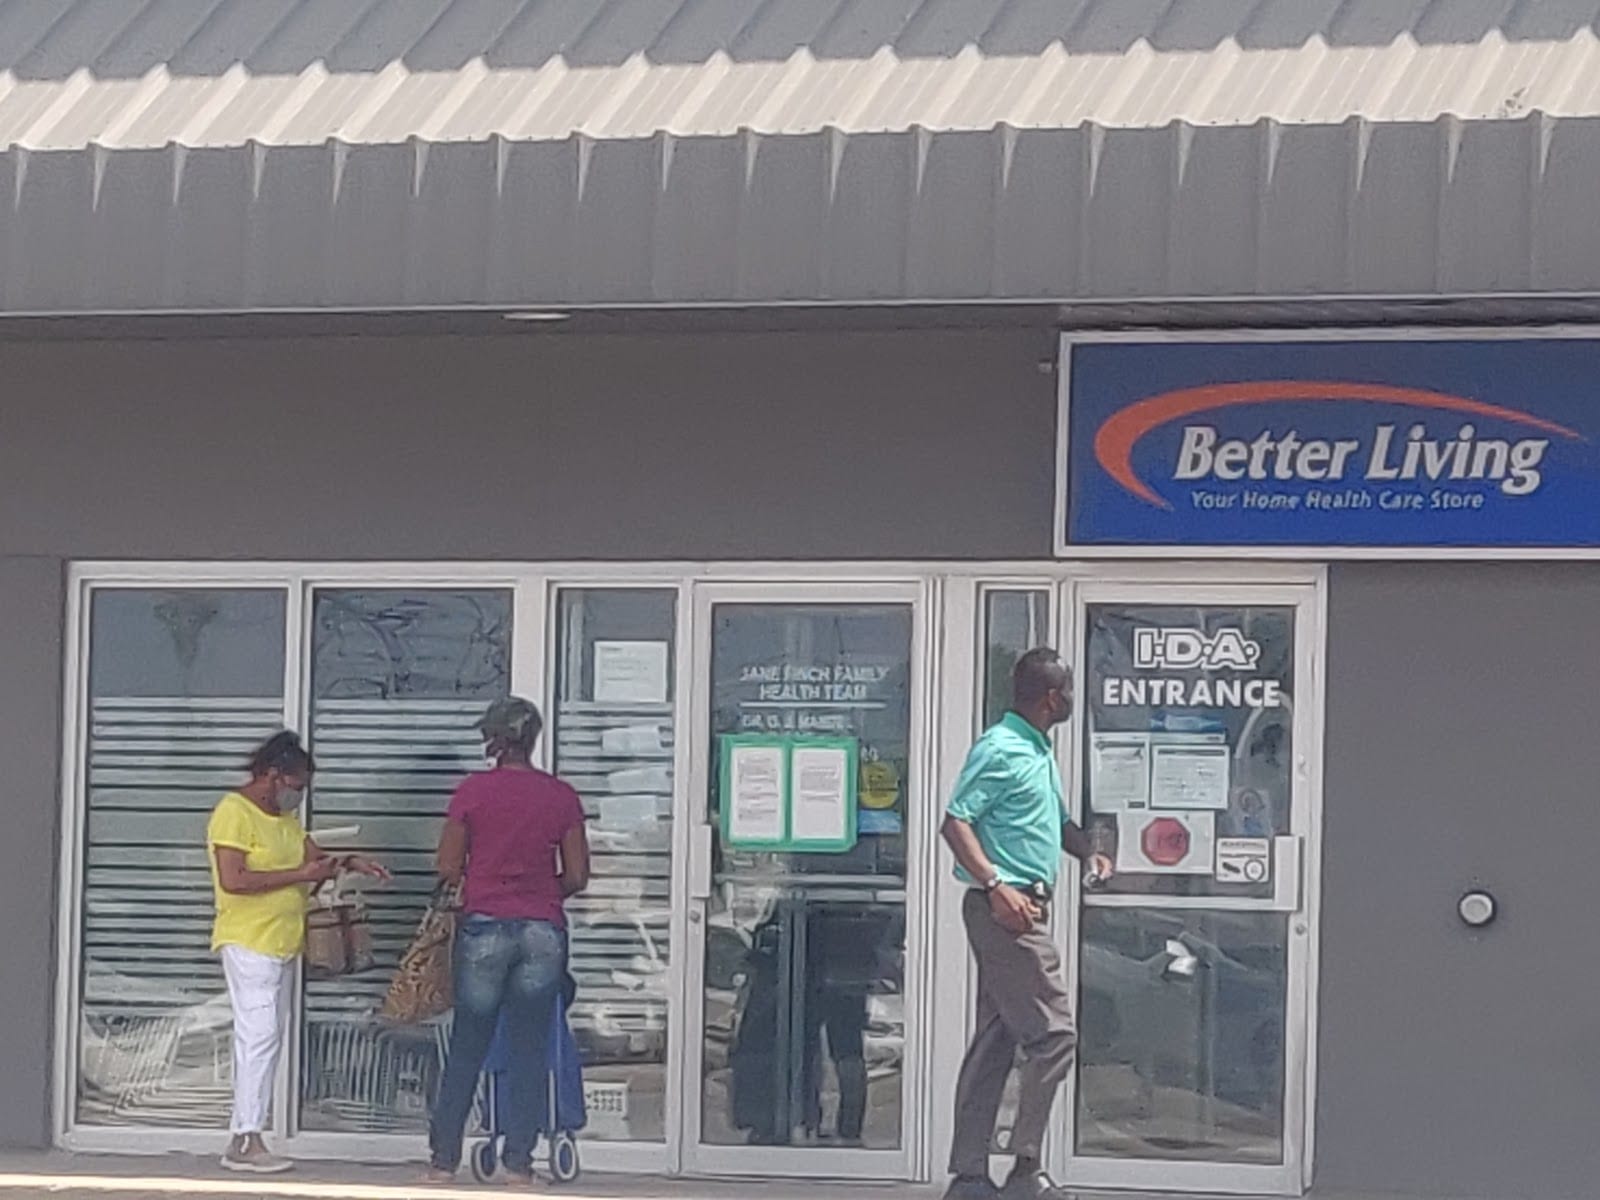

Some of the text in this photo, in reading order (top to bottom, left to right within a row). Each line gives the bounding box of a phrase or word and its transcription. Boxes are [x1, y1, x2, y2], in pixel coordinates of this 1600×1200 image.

[1178, 424, 1549, 495] Better Living
[1191, 490, 1485, 509] Your Home Health Care Store
[1103, 677, 1281, 708] ENTRANCE
